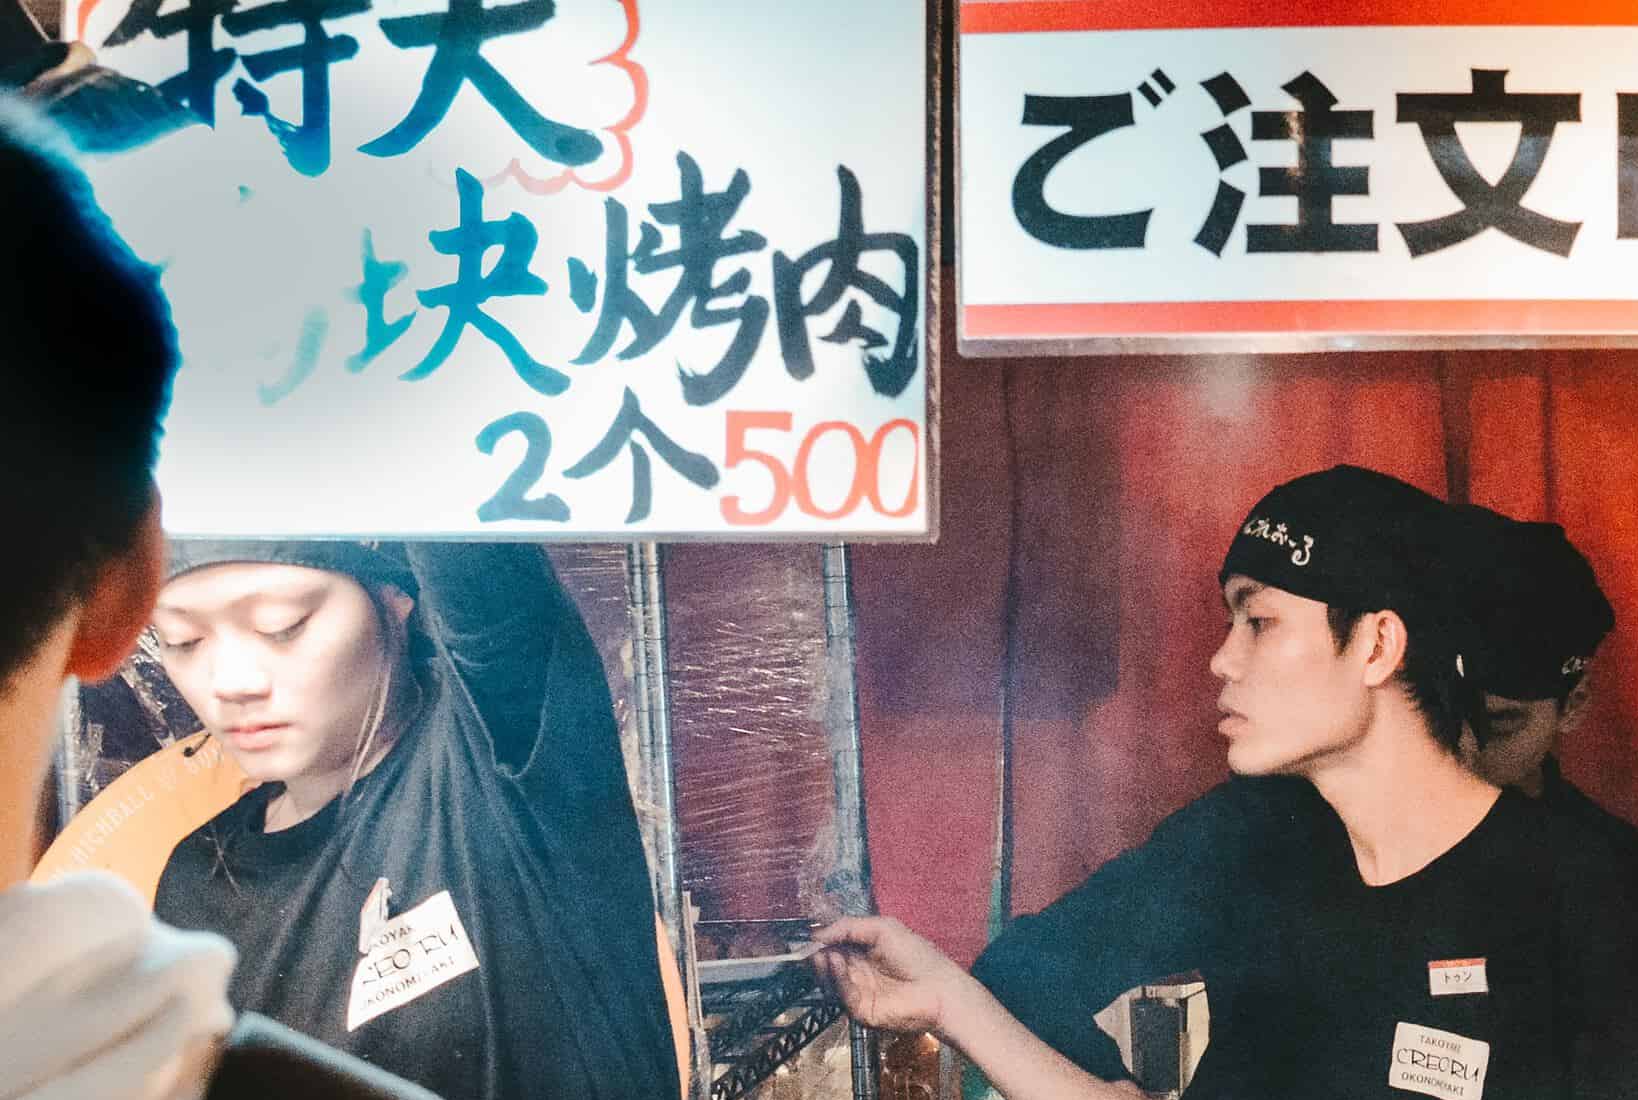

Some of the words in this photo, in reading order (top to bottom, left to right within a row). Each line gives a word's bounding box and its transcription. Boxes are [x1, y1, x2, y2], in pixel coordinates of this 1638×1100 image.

[102, 0, 604, 177] 特大
[258, 150, 919, 406] 块烤肉
